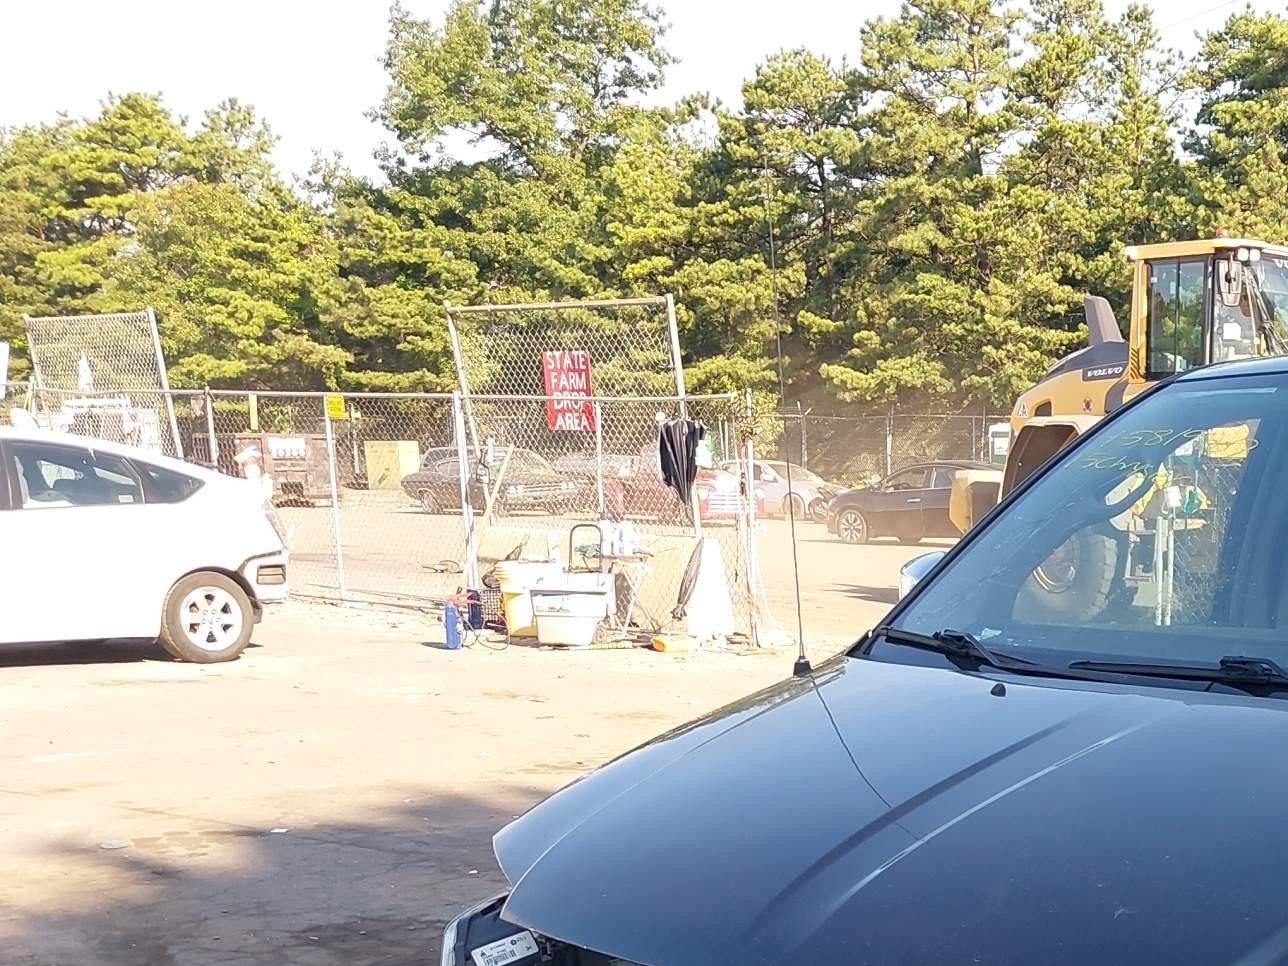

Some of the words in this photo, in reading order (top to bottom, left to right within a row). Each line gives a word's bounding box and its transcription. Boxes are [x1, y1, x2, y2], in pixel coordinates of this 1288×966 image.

[546, 351, 587, 369] STATE
[550, 371, 587, 390] FARM
[1087, 366, 1124, 378] VOLVO
[553, 391, 587, 410] DROP
[554, 412, 591, 431] AREA
